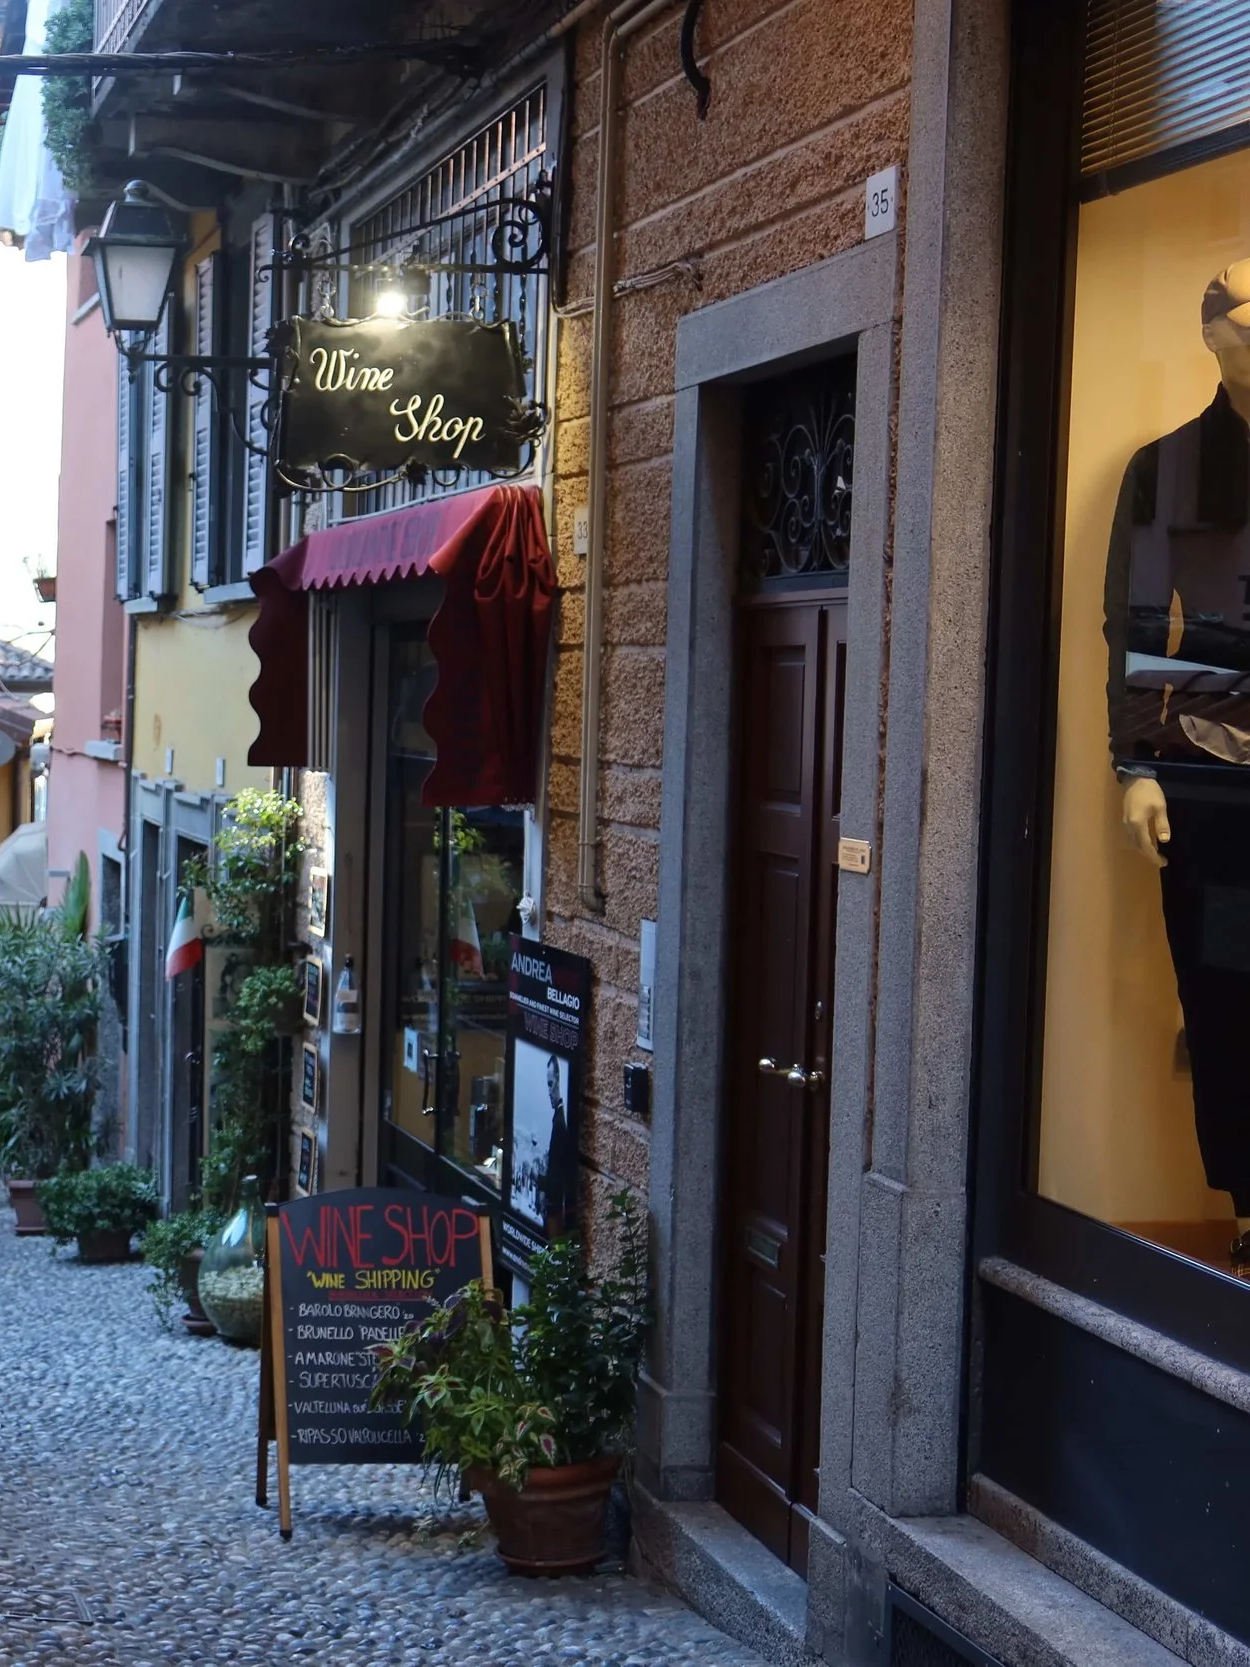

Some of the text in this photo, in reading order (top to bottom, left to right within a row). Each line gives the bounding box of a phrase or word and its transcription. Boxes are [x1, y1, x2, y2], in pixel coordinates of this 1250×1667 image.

[871, 187, 889, 217] 35
[309, 347, 395, 391] Wine
[389, 393, 486, 459] Shop
[577, 520, 588, 540] 33
[511, 952, 552, 985] ANDREA
[547, 987, 580, 1010] BELLAGIO
[524, 1011, 549, 1040] WINE
[550, 1022, 580, 1050] SHOP
[281, 1204, 479, 1269] WINE SHOP
[298, 1302, 342, 1318] BAROLO
[297, 1325, 354, 1341] BRUNELLO
[295, 1351, 354, 1367] AMARONE
[297, 1428, 348, 1444] RIPASSO
